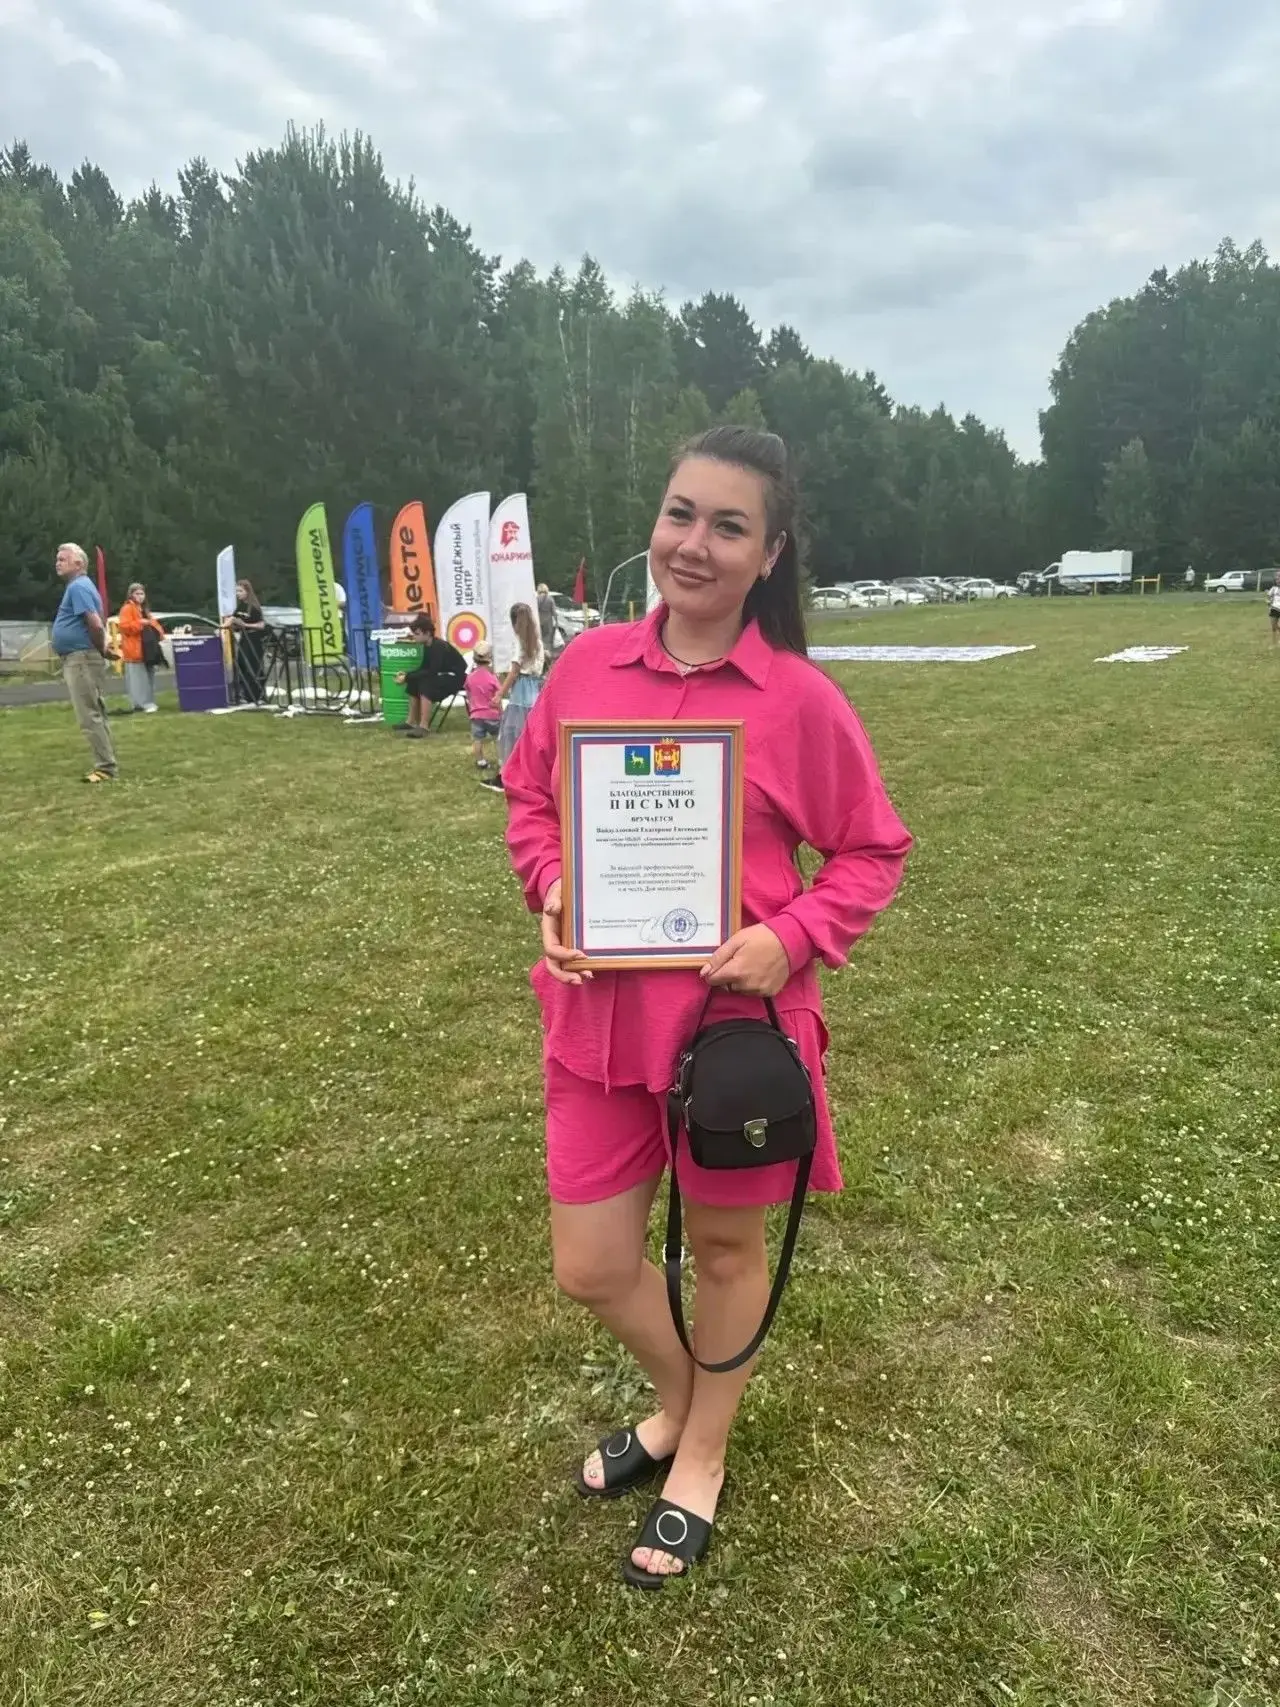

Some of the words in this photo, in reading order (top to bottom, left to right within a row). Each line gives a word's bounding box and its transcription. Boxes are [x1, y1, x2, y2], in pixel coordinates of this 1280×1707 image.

[451, 523, 464, 606] МОЛОДЁЖНЫЙ
[308, 528, 336, 649] достигаем
[464, 570, 475, 606] ЦЕНТР
[609, 789, 695, 798] БЛАГОДАРСТВЕННОЕ
[610, 798, 695, 810] ПИСЬМО
[631, 815, 674, 823] ВРУЧАЕТСЯ
